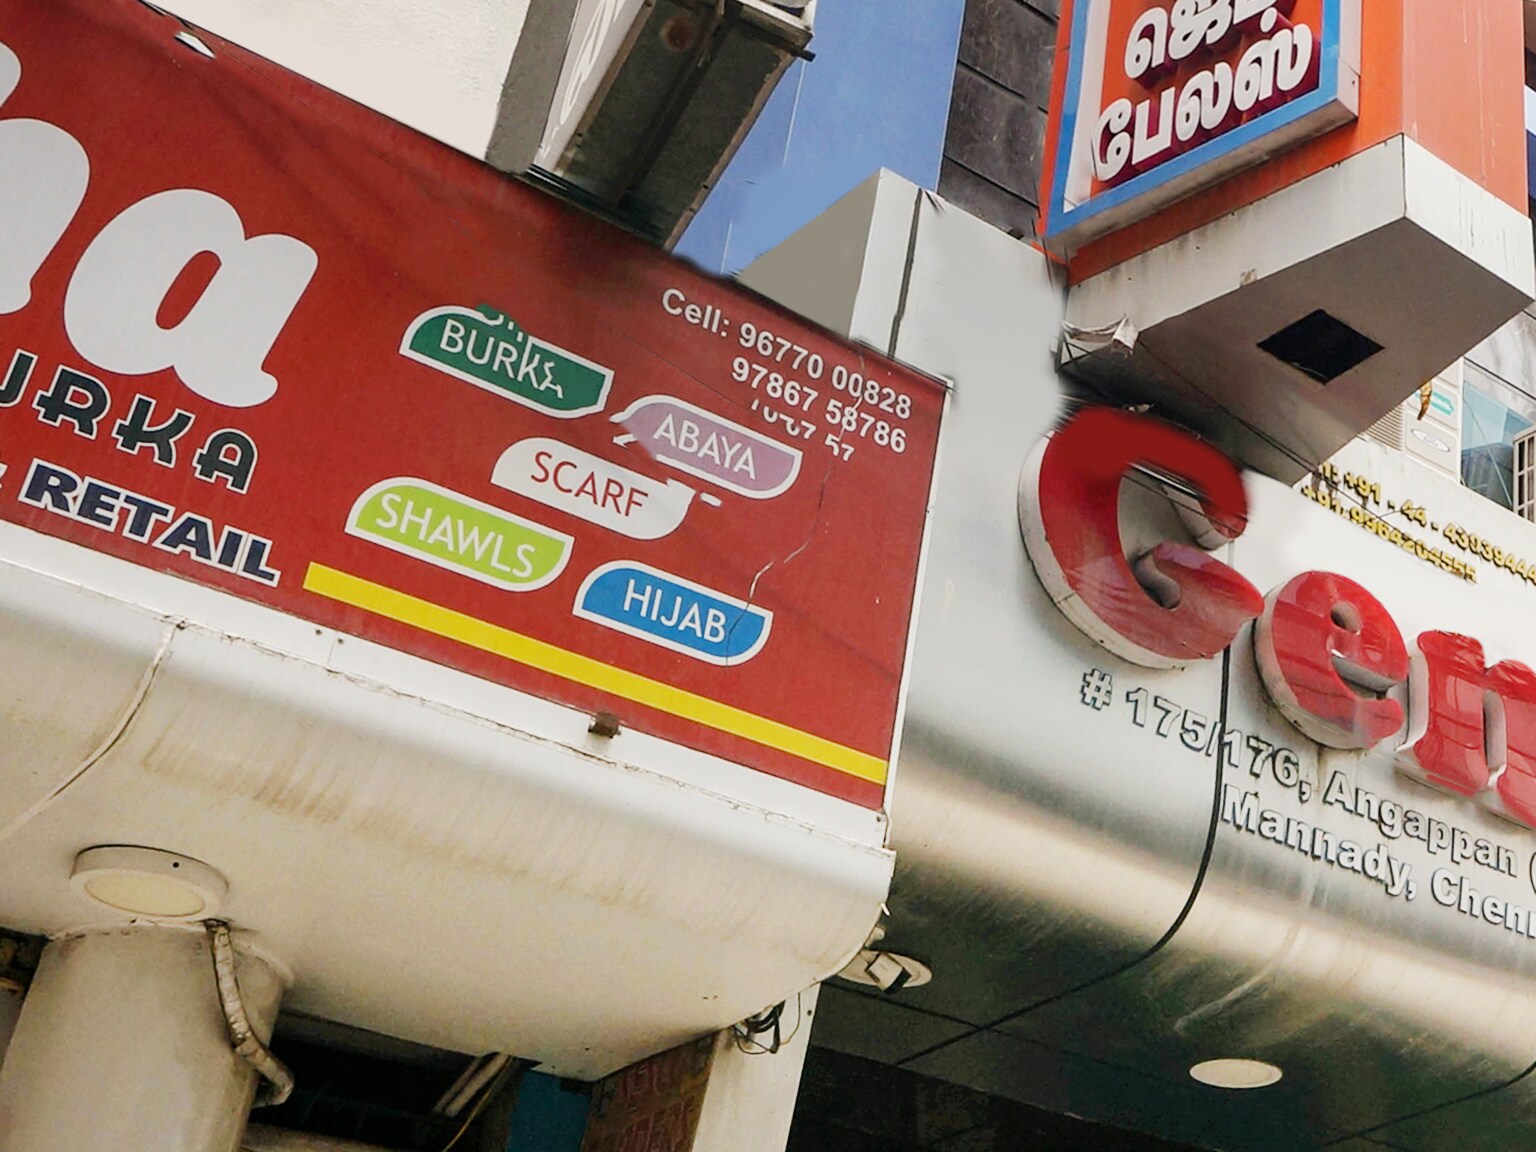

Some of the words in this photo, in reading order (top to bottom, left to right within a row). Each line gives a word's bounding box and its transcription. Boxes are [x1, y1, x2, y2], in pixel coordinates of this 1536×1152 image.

[1095, 8, 1313, 181] பேலஸ்
[662, 288, 730, 338] Cell:
[738, 323, 824, 380] 96770
[831, 365, 912, 420] 00828
[731, 356, 819, 412] 97867
[825, 399, 907, 454] 58786
[530, 450, 650, 518] SCARF
[653, 413, 758, 480] ABAYA
[18, 457, 281, 588] RETAIL
[375, 493, 536, 579] SHAWLS
[623, 579, 728, 645] HIJAB
[1126, 687, 1312, 802] 175/176,
[1324, 770, 1517, 877] Angappan
[1221, 784, 1417, 898] Mannady,
